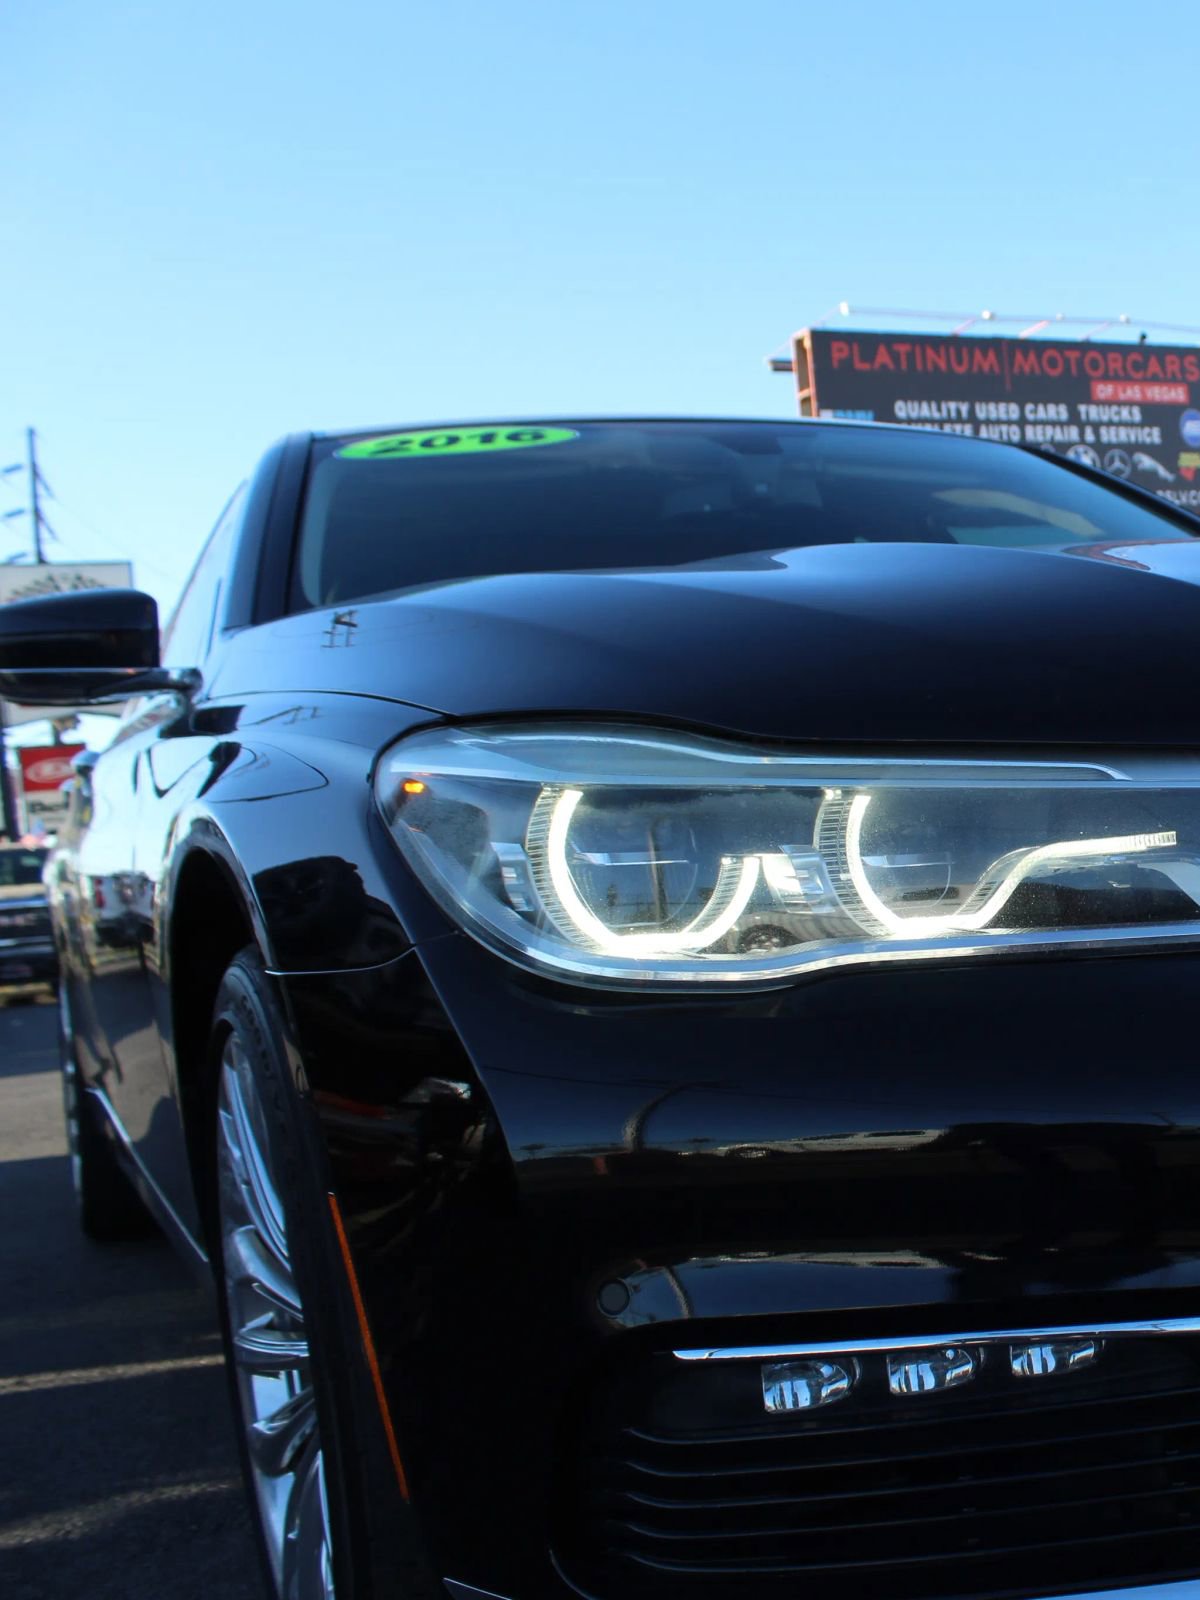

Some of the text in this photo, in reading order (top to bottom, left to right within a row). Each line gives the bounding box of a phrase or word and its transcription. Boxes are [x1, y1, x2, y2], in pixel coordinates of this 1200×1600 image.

[830, 341, 1200, 382] PLATINUM MOTORCARS
[1096, 383, 1185, 401] OF LAS VEGAS
[894, 400, 969, 420] QUALITY
[975, 402, 1021, 421] USED
[1024, 403, 1069, 422] CARS
[1077, 404, 1142, 423] TRUCKS
[366, 429, 547, 457] 2016
[978, 423, 1022, 442] AUTO
[1025, 424, 1080, 442] REPAIR
[1084, 425, 1096, 443] &
[1100, 426, 1162, 444] SERVICE
